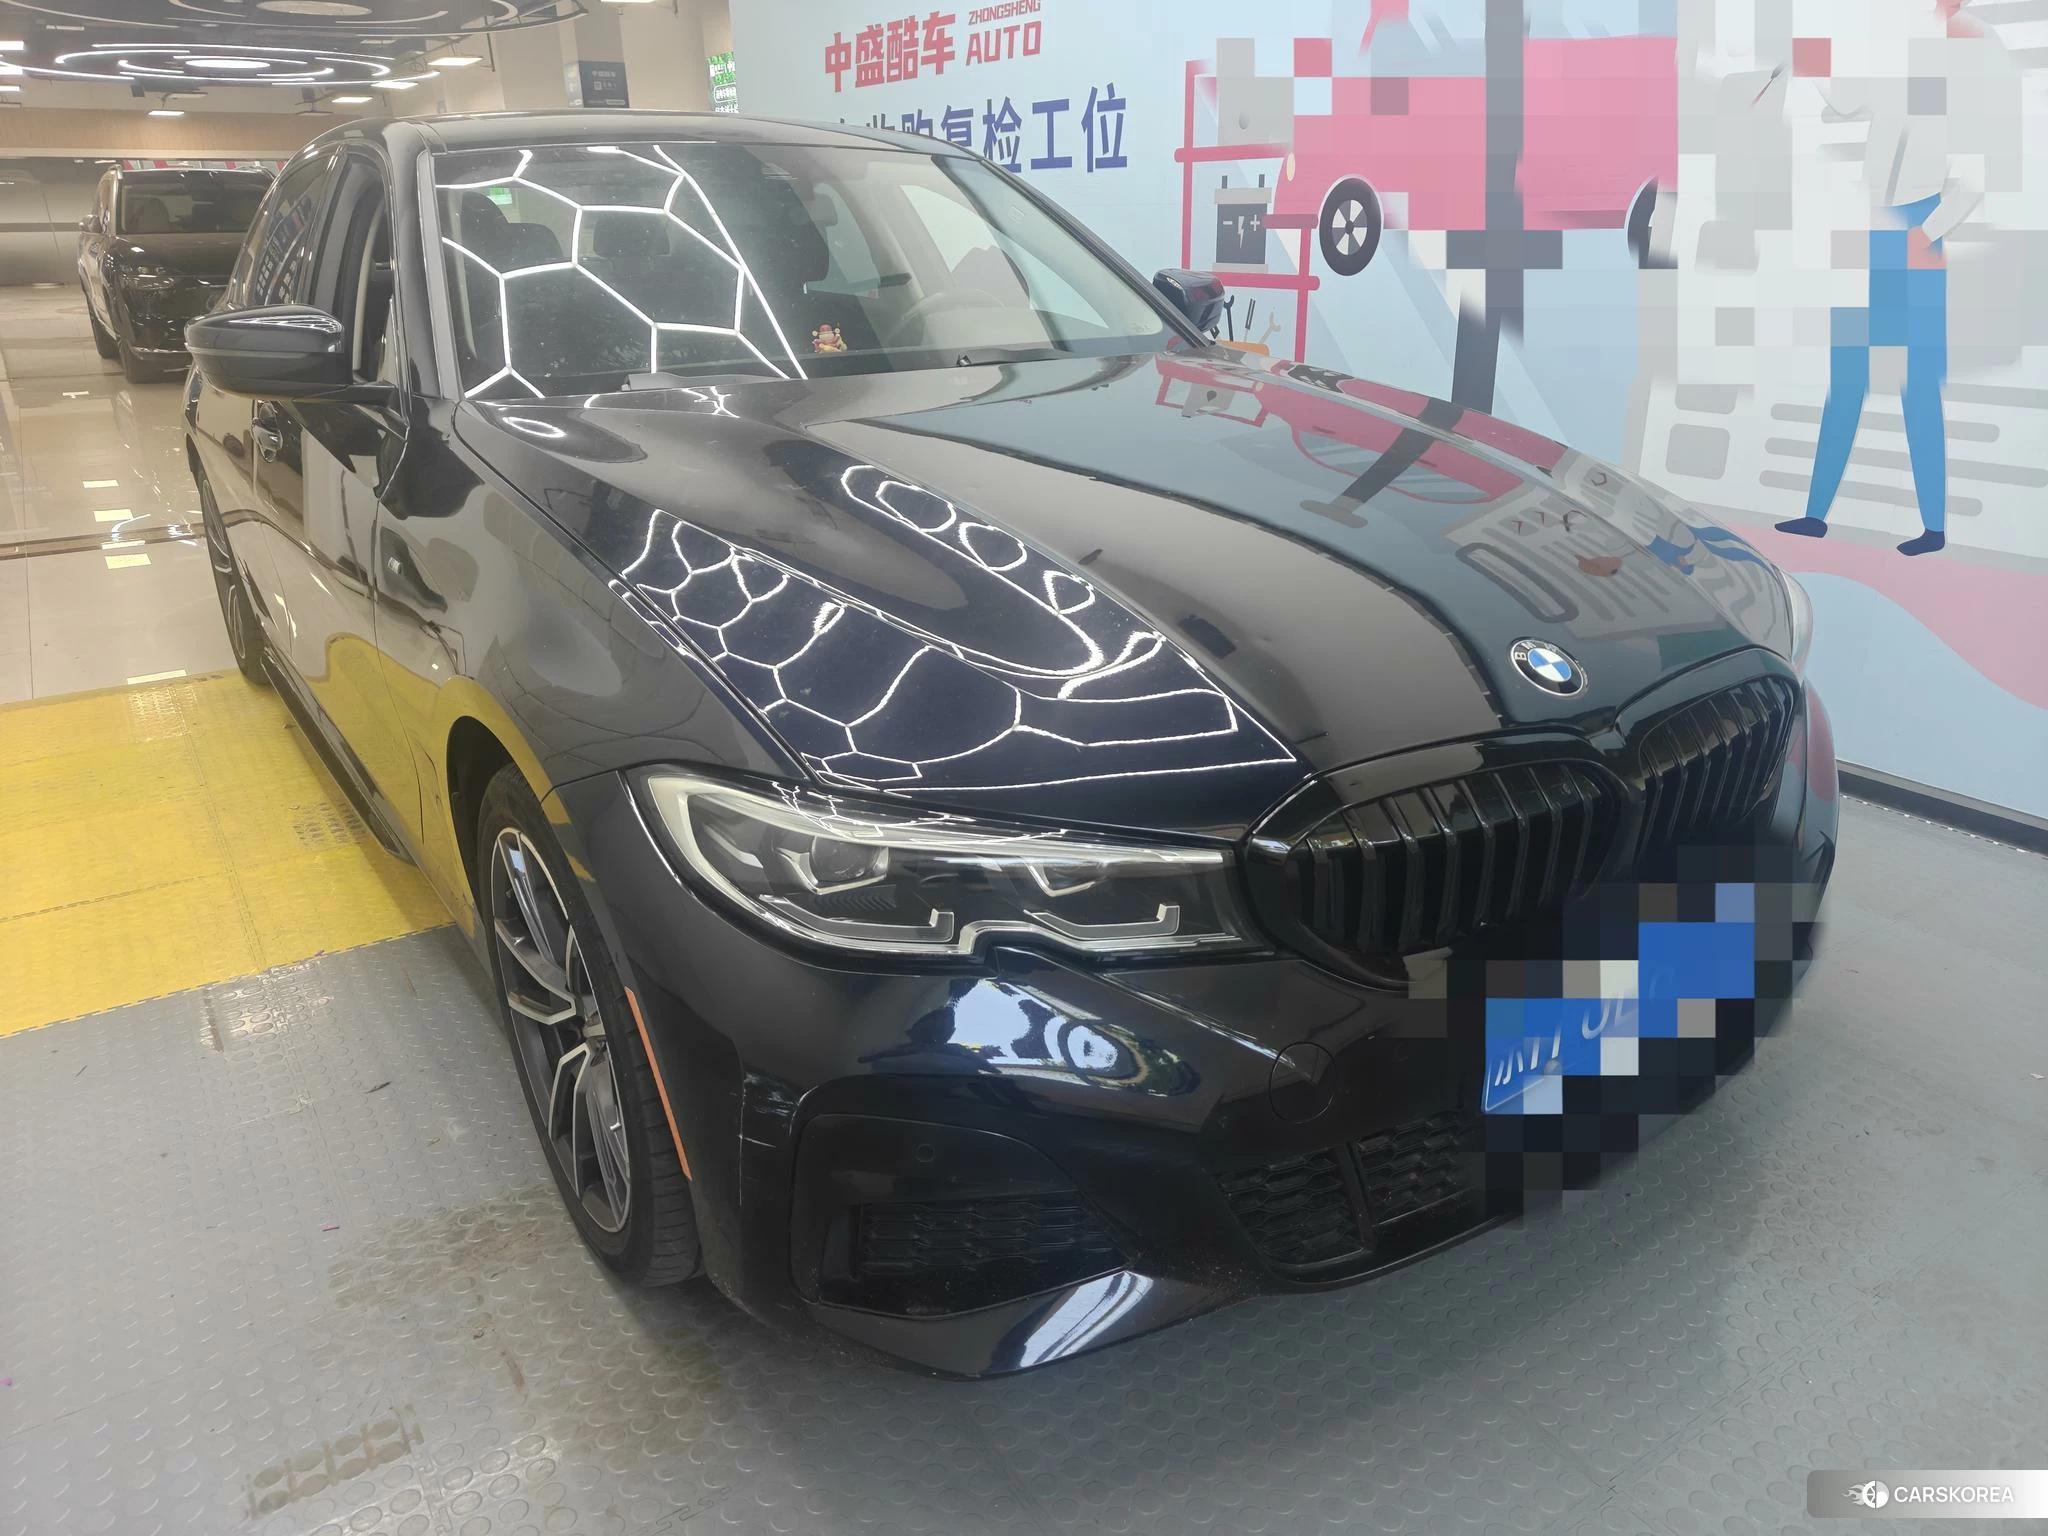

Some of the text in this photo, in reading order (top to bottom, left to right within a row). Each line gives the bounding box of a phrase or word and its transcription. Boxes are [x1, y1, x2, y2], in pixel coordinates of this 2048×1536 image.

[968, 0, 1041, 26] ZHONGSHENG
[825, 11, 956, 93] 中盛酷车
[966, 21, 1042, 66] AUTO
[1514, 641, 1559, 661] BMW
